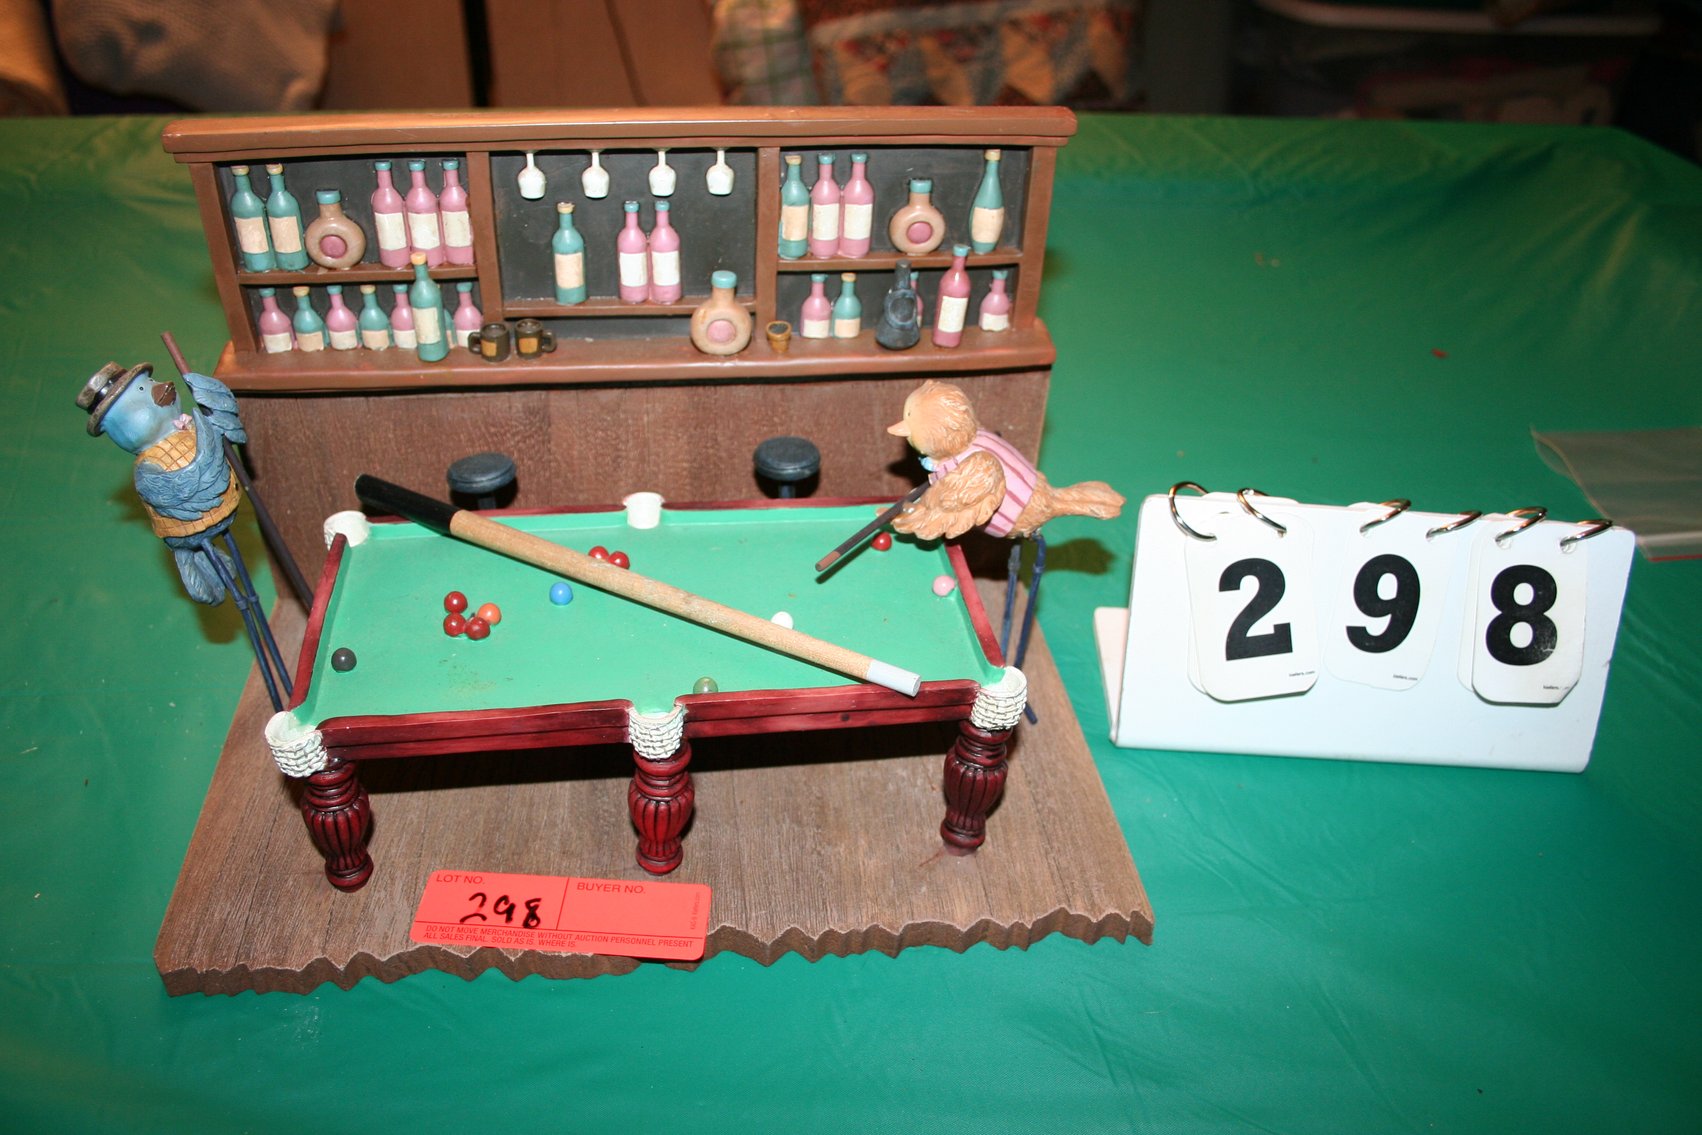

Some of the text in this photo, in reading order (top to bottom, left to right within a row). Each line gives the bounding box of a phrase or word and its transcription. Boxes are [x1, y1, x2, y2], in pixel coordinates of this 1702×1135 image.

[435, 874, 486, 885] LOT NO.
[576, 882, 646, 894] BUYER NO.
[459, 892, 542, 929] 298
[438, 925, 455, 933] NOT
[456, 926, 478, 935] MOVE
[480, 928, 536, 938] MERCHANDISE
[537, 931, 573, 940] WITHOUT
[574, 934, 609, 943] AUCTION
[610, 936, 656, 946] PERSONNEL
[658, 939, 693, 948] PRESENT
[439, 933, 464, 941] SALES
[490, 936, 513, 944] SOLD
[538, 940, 566, 948] WHERE
